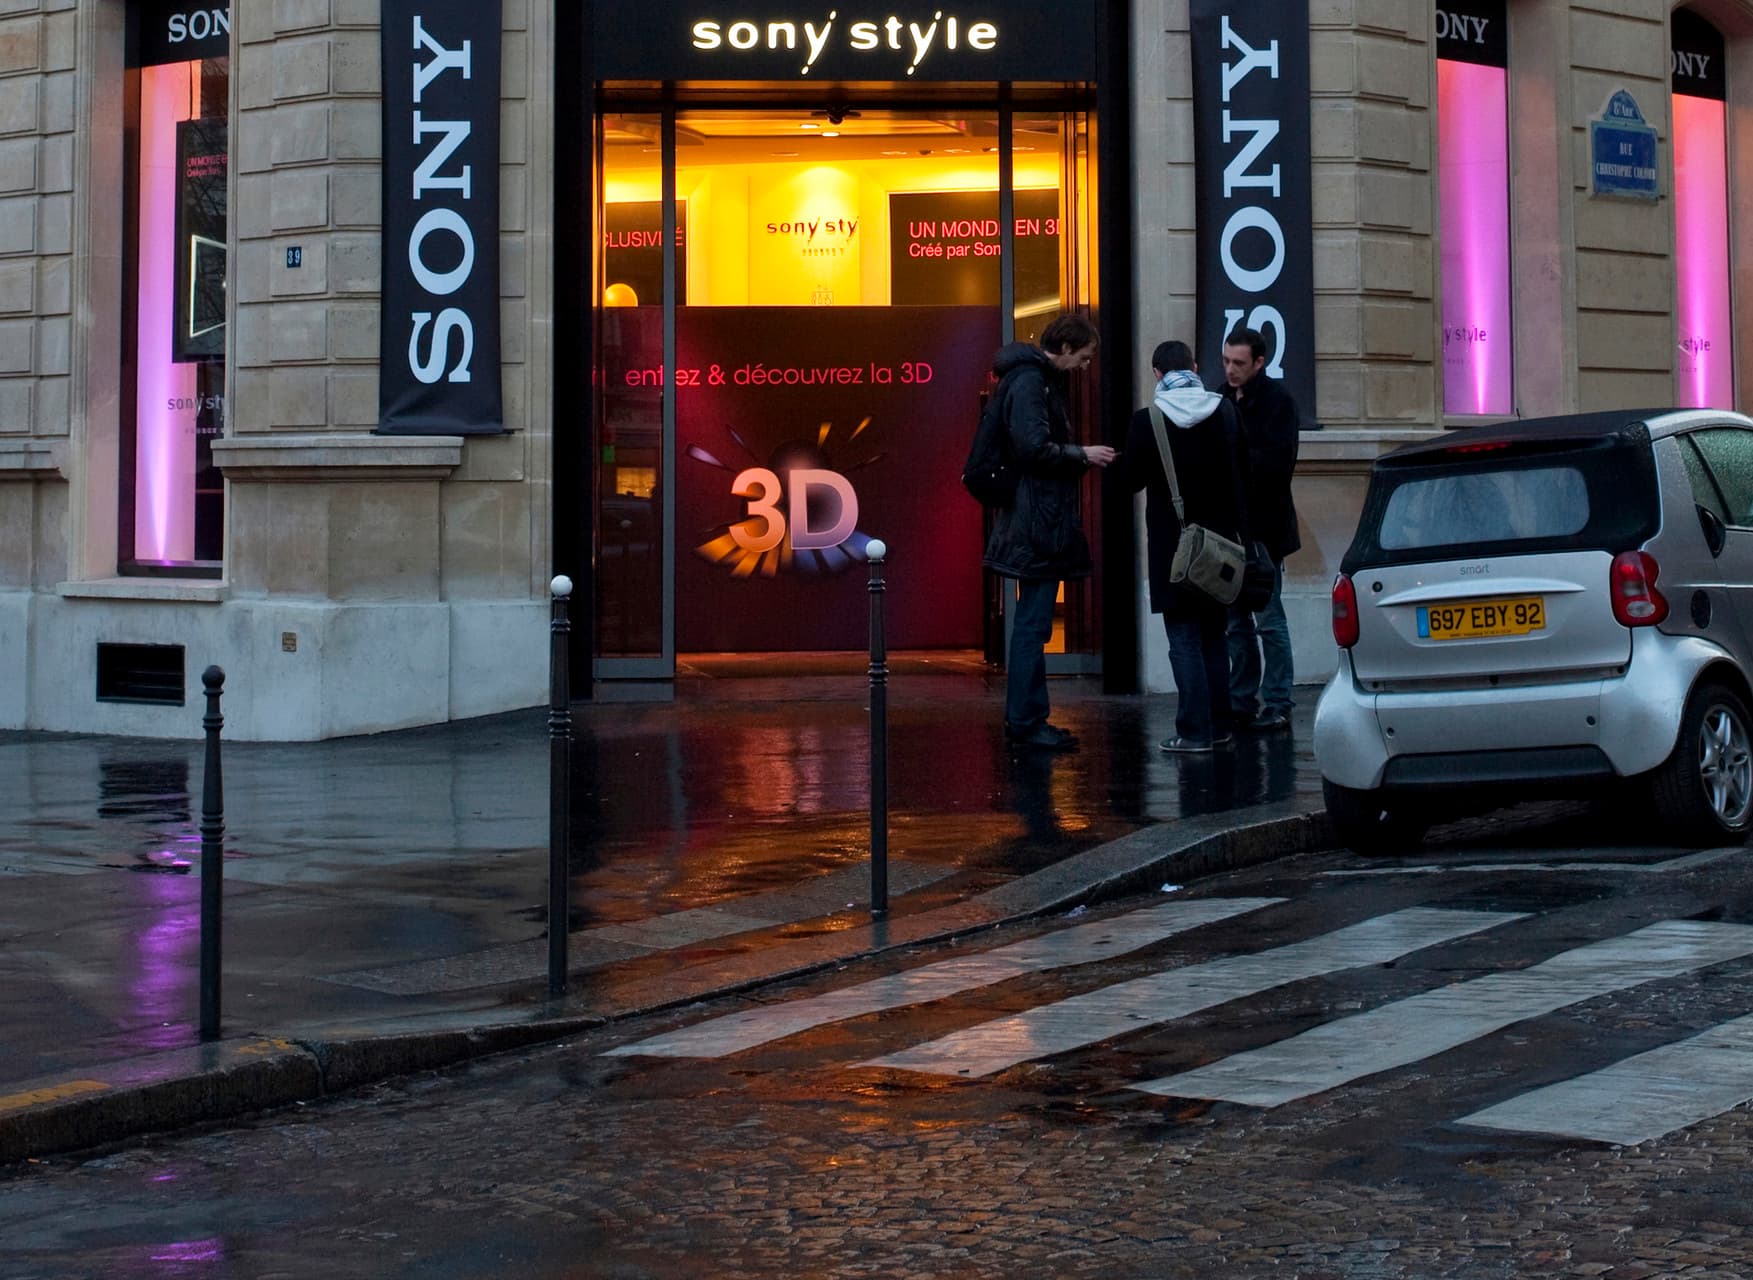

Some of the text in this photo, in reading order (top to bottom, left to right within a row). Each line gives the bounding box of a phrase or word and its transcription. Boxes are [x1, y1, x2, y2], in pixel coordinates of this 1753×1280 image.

[692, 10, 998, 75] sony style
[408, 15, 474, 384] SONY
[1220, 15, 1286, 379] SONY
[767, 216, 820, 246] sony
[909, 221, 936, 239] UN
[941, 220, 1000, 238] MOND
[1015, 218, 1040, 236] EN
[909, 241, 1000, 260] Créé par Son
[625, 362, 933, 386] entez & découvrez la 3D
[167, 392, 205, 421] sony
[729, 467, 858, 552] 3D
[1460, 563, 1490, 576] smart
[1430, 603, 1541, 631] 697 EBY 92
